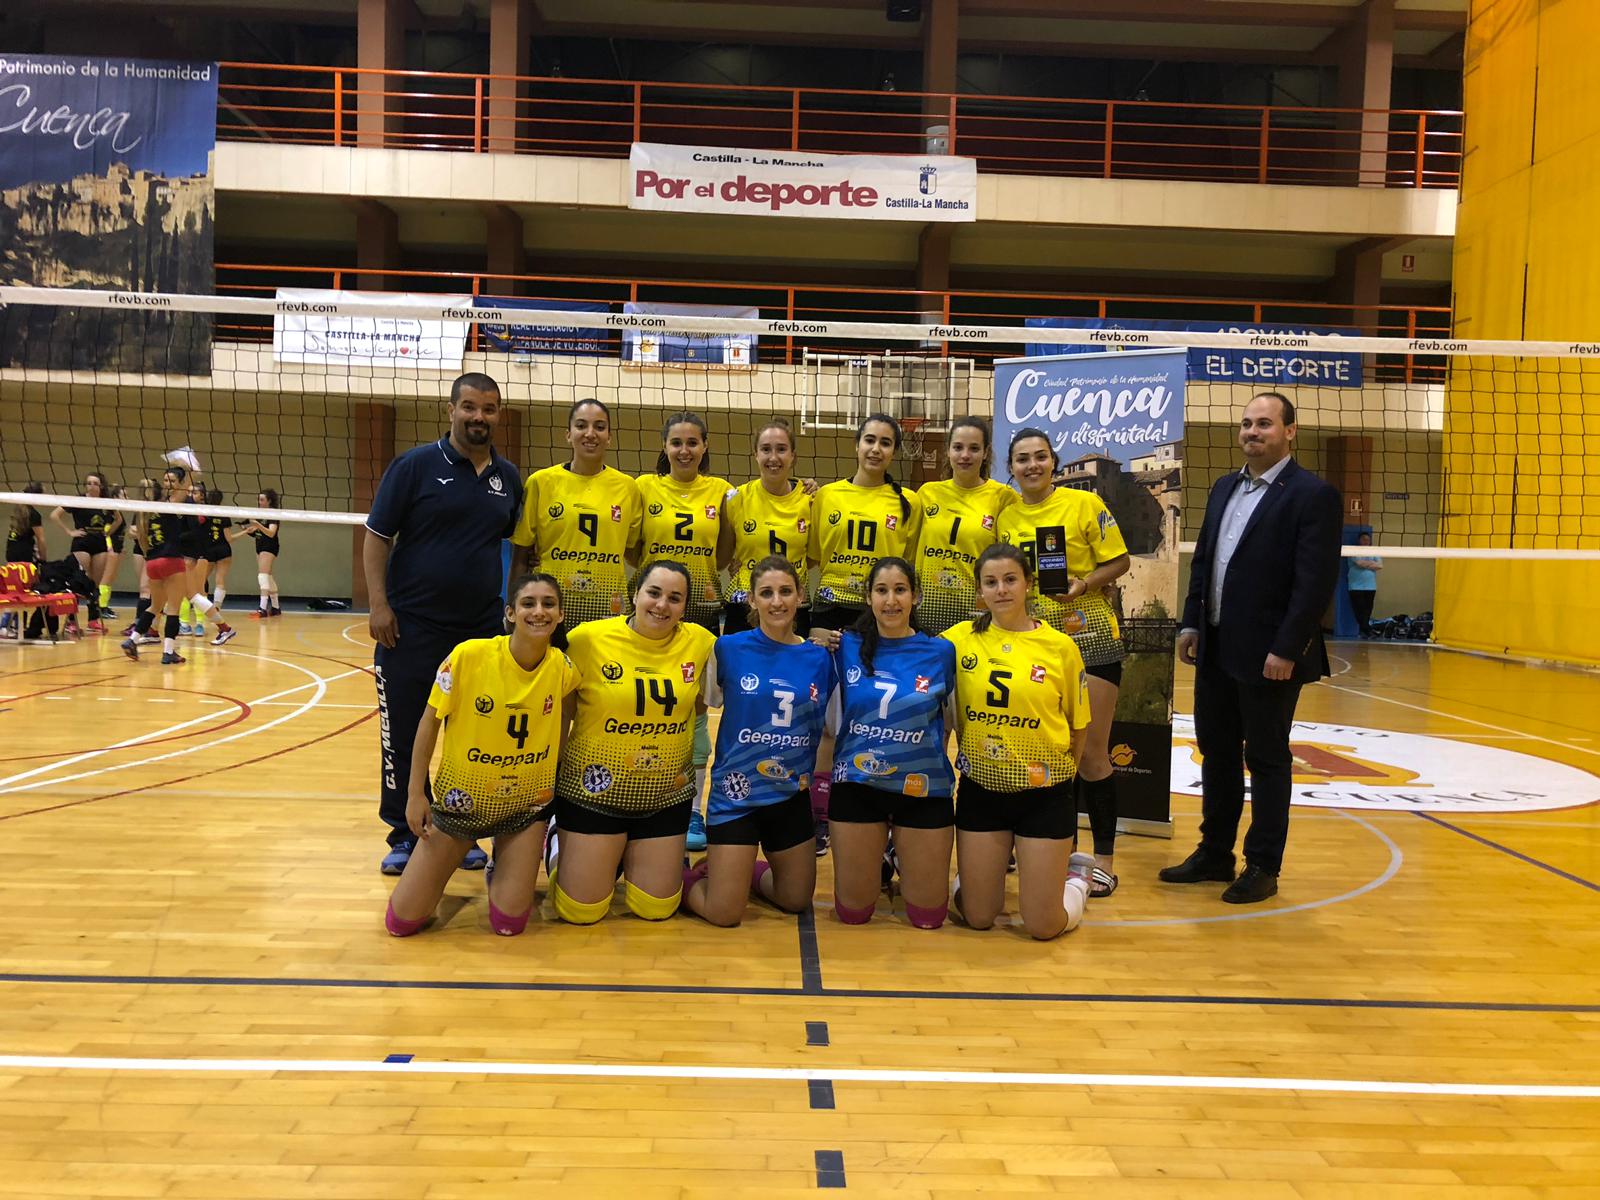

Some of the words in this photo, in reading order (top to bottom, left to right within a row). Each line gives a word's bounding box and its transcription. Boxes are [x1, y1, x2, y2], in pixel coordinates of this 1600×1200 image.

[0, 59, 76, 75] Patrimonio
[81, 60, 99, 76] de
[105, 61, 118, 77] la
[124, 64, 211, 81] Humanidad
[0, 84, 141, 153] Cuenca
[693, 153, 742, 165] Castilla
[752, 156, 769, 166] La
[772, 158, 824, 168] Mancha
[635, 170, 691, 199] Por
[694, 182, 714, 198] el
[720, 175, 878, 210] deporte
[885, 197, 932, 209] Castilla-La
[935, 199, 969, 210] Mancha
[108, 294, 171, 306] rfevb.com
[276, 301, 337, 313] rfevb.com
[442, 307, 502, 320] rfevb.com
[606, 314, 666, 327] rfevb.com
[768, 321, 827, 333] rfevb.com
[929, 326, 988, 338] rfevb.com
[1090, 331, 1149, 343] rfevb.com
[1250, 335, 1308, 347] rfevb.com
[1409, 340, 1468, 351] rfevb.com
[1206, 355, 1234, 376] EL
[1242, 357, 1350, 381] DEPORTE
[1005, 369, 1172, 426] Cuenca
[1053, 430, 1068, 451] y
[1071, 421, 1169, 447] disfrútala!
[578, 513, 598, 546] 9
[674, 513, 694, 541] 2
[848, 519, 877, 551] 10
[950, 517, 961, 545] 1
[649, 542, 714, 558] Geeppard
[830, 552, 879, 569] Geeppa
[635, 678, 677, 716] 14
[874, 681, 897, 719] 7
[986, 670, 1012, 708] 5
[771, 690, 794, 727] 3
[507, 713, 529, 749] 4
[468, 745, 550, 769] Geeppard
